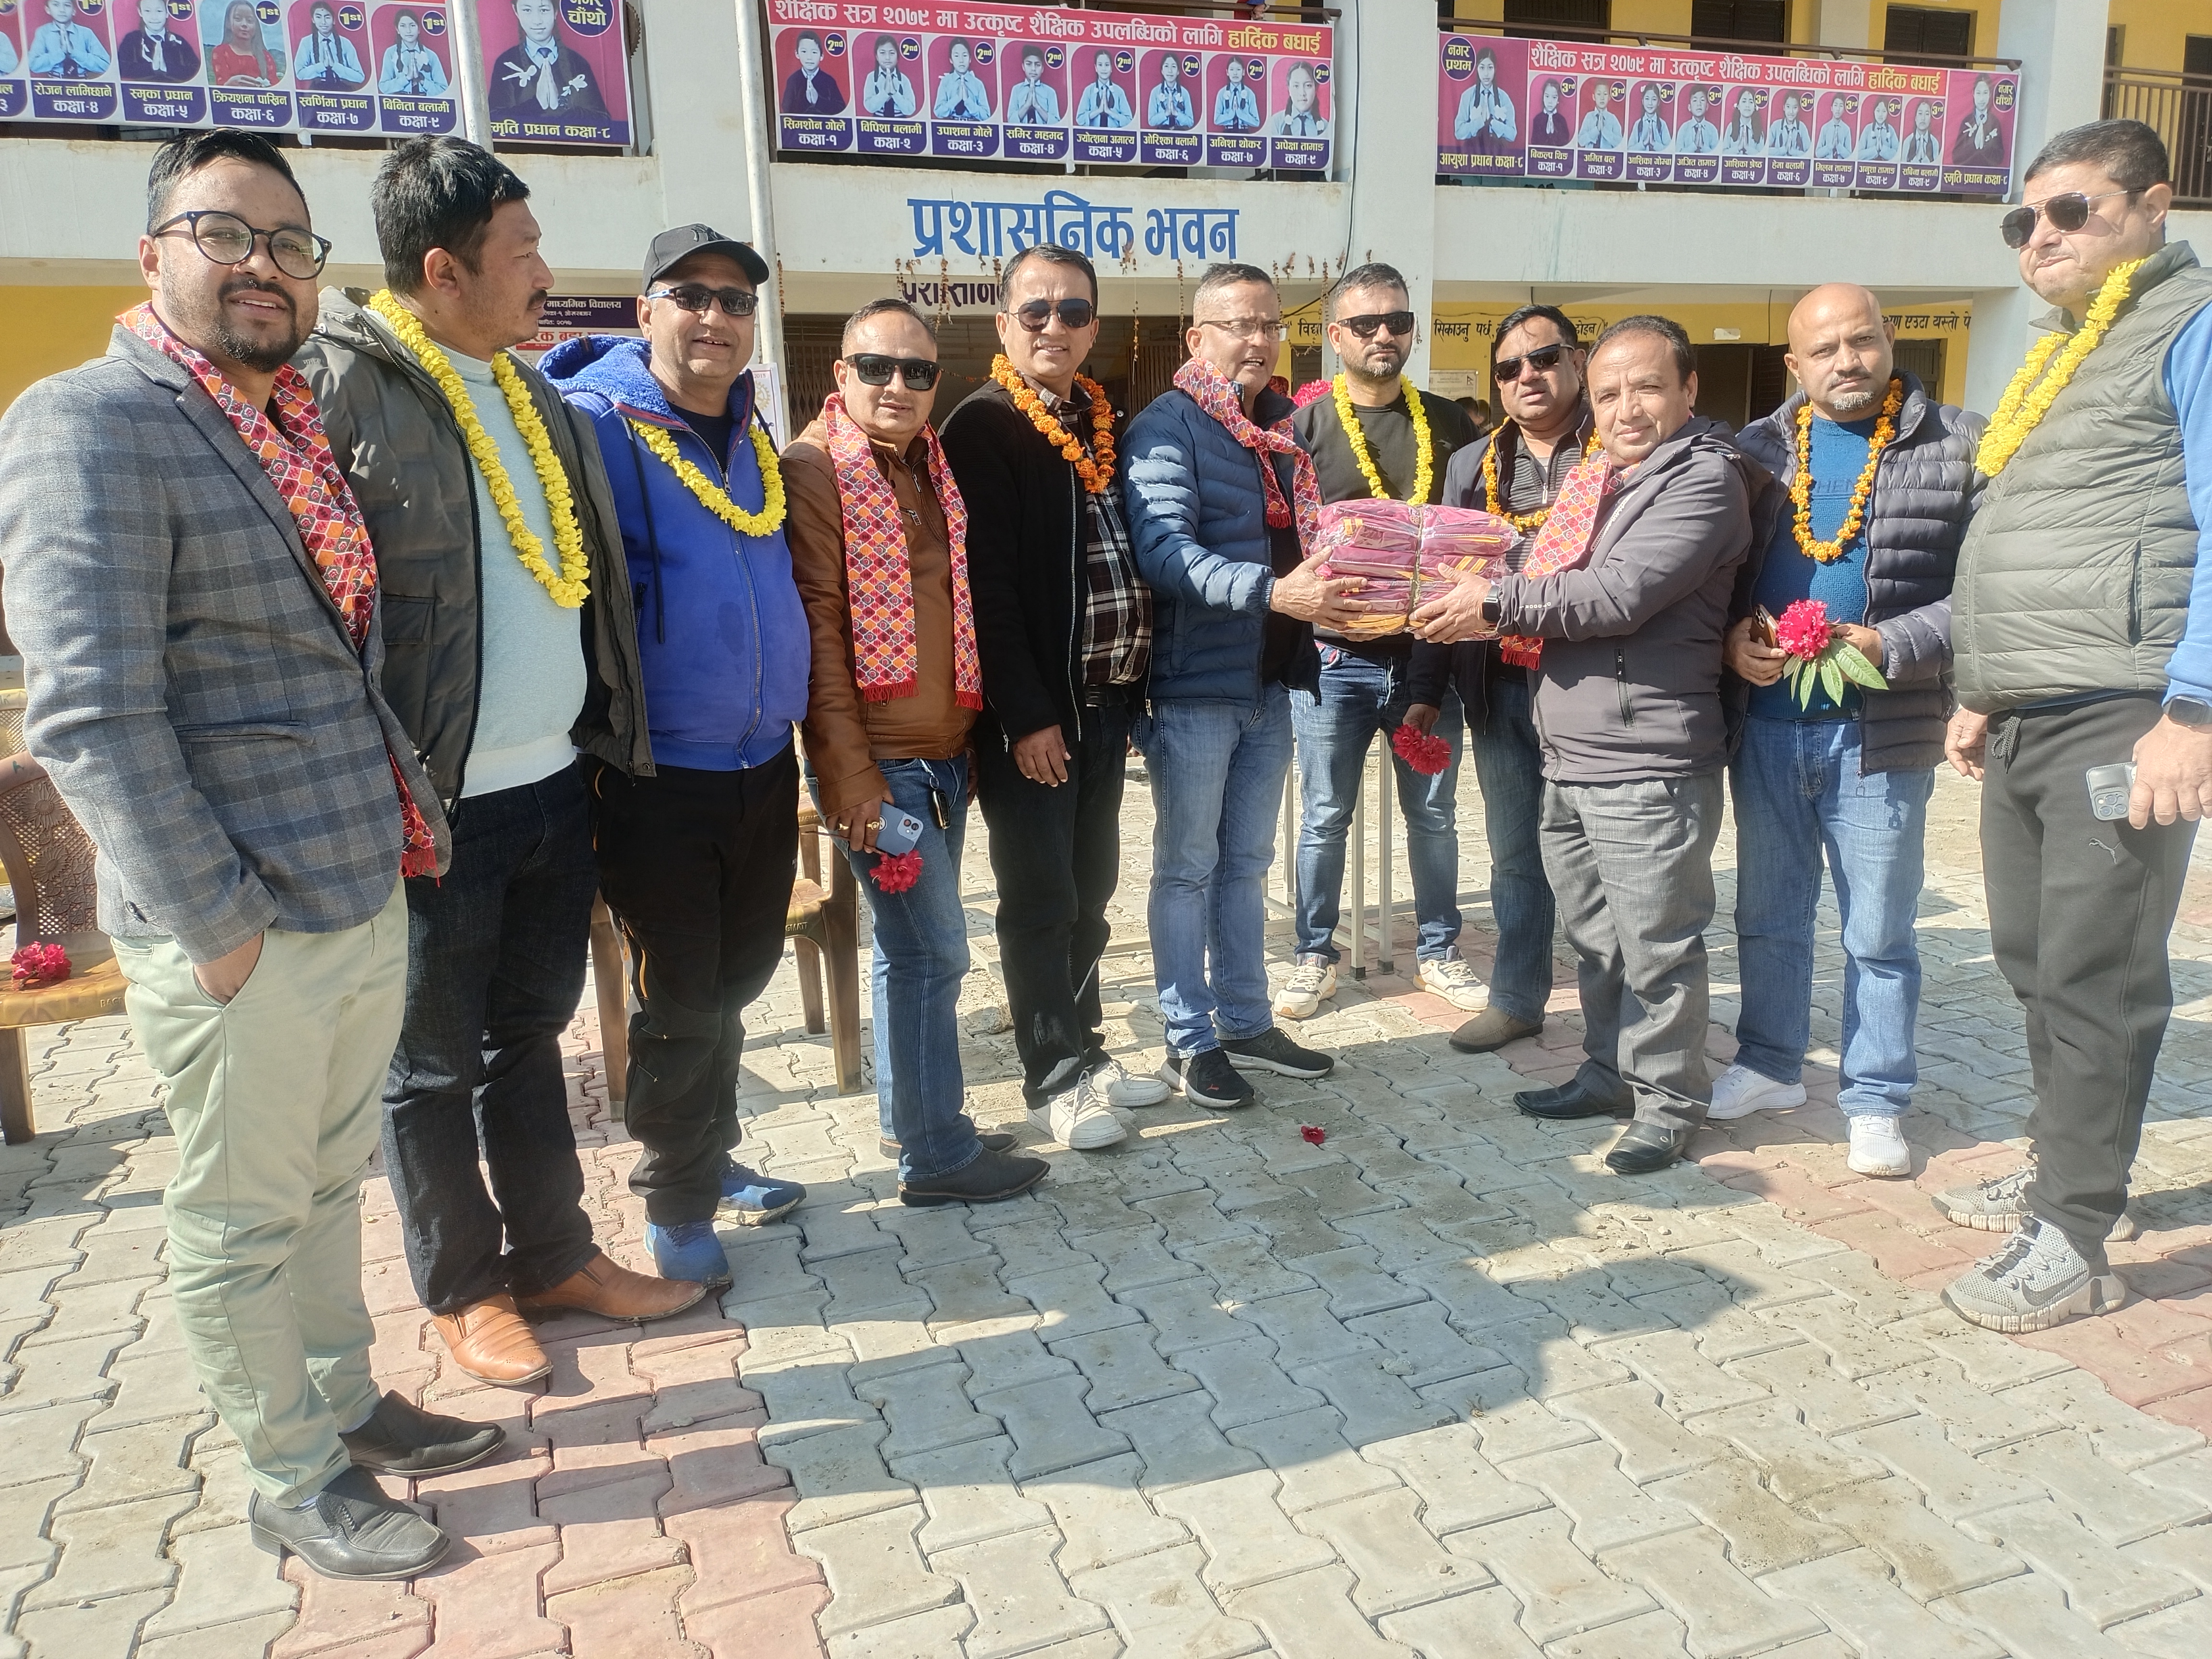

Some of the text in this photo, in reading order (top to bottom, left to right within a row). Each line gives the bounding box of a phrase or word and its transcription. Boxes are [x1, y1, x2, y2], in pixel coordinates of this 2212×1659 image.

[168, 3, 192, 15] 1st
[256, 6, 279, 20] 1st
[341, 12, 362, 25] 1st
[423, 17, 445, 30] 1st
[843, 4, 878, 24] सत्र
[883, 7, 930, 26] २०७९
[936, 10, 959, 28] मा
[963, 12, 1024, 37] उत्कृष्ट
[1029, 11, 1085, 38] शैक्षिक
[1090, 18, 1178, 43] उपलब्धिको
[1182, 23, 1224, 46] लागि
[1227, 25, 1279, 49] हार्दिक
[1283, 31, 1322, 55] बधाई
[828, 38, 845, 51] 2nd
[902, 43, 918, 56] 2nd
[1447, 44, 1471, 58] नगर
[977, 48, 992, 60] 2nd
[1046, 52, 1062, 64] 2nd
[1117, 56, 1133, 70] 2nd
[1184, 60, 1199, 73] 2nd
[1445, 58, 1472, 72] प्रथम
[1531, 42, 1941, 95] शैक्षिक सत्र २०७९ मा उत्कृष्ट शैक्षिक उपलब्धिको लागि हार्दिक बधाई
[1250, 65, 1263, 77] 2nd
[1316, 69, 1329, 80] 2nd
[34, 82, 112, 97] रोजन लामिछाने
[1562, 82, 1576, 94] 3rd
[1611, 86, 1625, 97] 3rd
[1660, 88, 1674, 99] 3rd
[164, 90, 193, 101] प्रधान
[299, 94, 368, 109] स्वर्णिमा प्रधान
[1709, 90, 1721, 101] 3rd
[1755, 94, 1768, 105] 3rd
[53, 100, 99, 114] कक्षा-४
[383, 97, 450, 113] बिनिता बलामी
[1801, 97, 1814, 108] 3rd
[1846, 100, 1858, 111] 3rd
[1888, 102, 1901, 112] 3rd
[143, 103, 188, 118] कक्षा-५
[230, 108, 275, 122] कक्षा-६
[1932, 105, 1944, 116] 3rd
[316, 111, 359, 125] कक्षा-७
[783, 117, 846, 132] सिमशोन गोले
[523, 123, 561, 136] प्रधान
[564, 125, 611, 139] कक्षा-८
[893, 123, 922, 134] बलामी
[973, 125, 993, 138] गोले
[1006, 127, 1032, 140] समिर
[798, 133, 837, 146] कक्षा-१
[874, 137, 911, 150] कक्षा-२
[947, 139, 984, 152] कक्षा-३
[1110, 135, 1135, 145] अमात्य
[1210, 136, 1237, 148] अनिशा
[1275, 139, 1298, 151] अपेक्षा
[1019, 143, 1055, 155] कक्षा-४
[1088, 145, 1122, 158] कक्षा-५
[1155, 148, 1189, 161] कक्षा-६
[1221, 151, 1253, 163] कक्षा-७
[1471, 154, 1493, 168] प्रधान
[1538, 161, 1563, 172] कक्षा-१
[1587, 165, 1612, 175] कक्षा-२
[1636, 167, 1660, 178] कक्षा-३
[1684, 168, 1708, 179] कक्षा-४
[1777, 171, 1800, 182] कक्षा-६
[1823, 173, 1845, 183] कक्षा-७
[1944, 169, 1962, 186] स्मृति
[1964, 173, 1983, 185] प्रधान
[907, 190, 1239, 260] प्रशासनिक भवन
[547, 299, 622, 309] माध्यमिक विद्यालय
